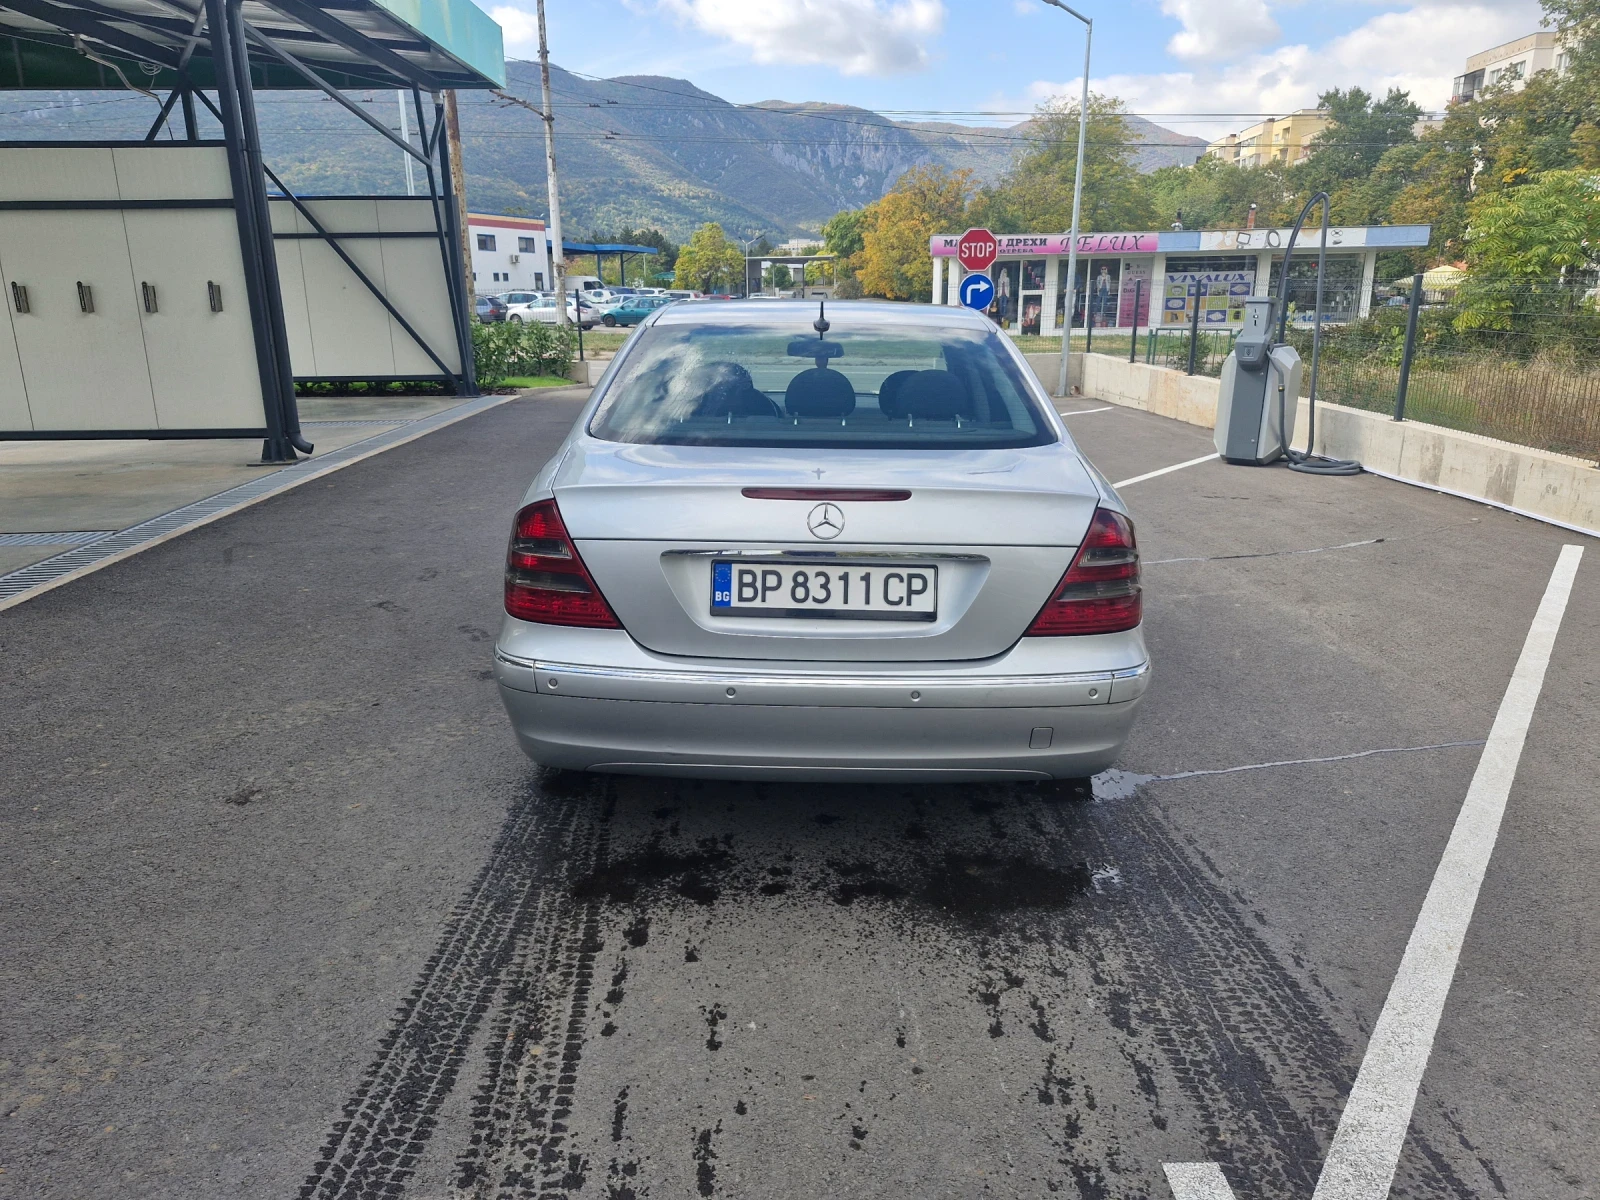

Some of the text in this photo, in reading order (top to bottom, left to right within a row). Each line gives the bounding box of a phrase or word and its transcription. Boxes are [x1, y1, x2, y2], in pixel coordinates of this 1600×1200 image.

[1006, 238, 1048, 248] ДРЕХИ
[961, 242, 995, 258] STOP
[1168, 273, 1252, 283] VIVALUX
[737, 569, 929, 607] BP 8311 CP
[715, 591, 731, 602] BG
